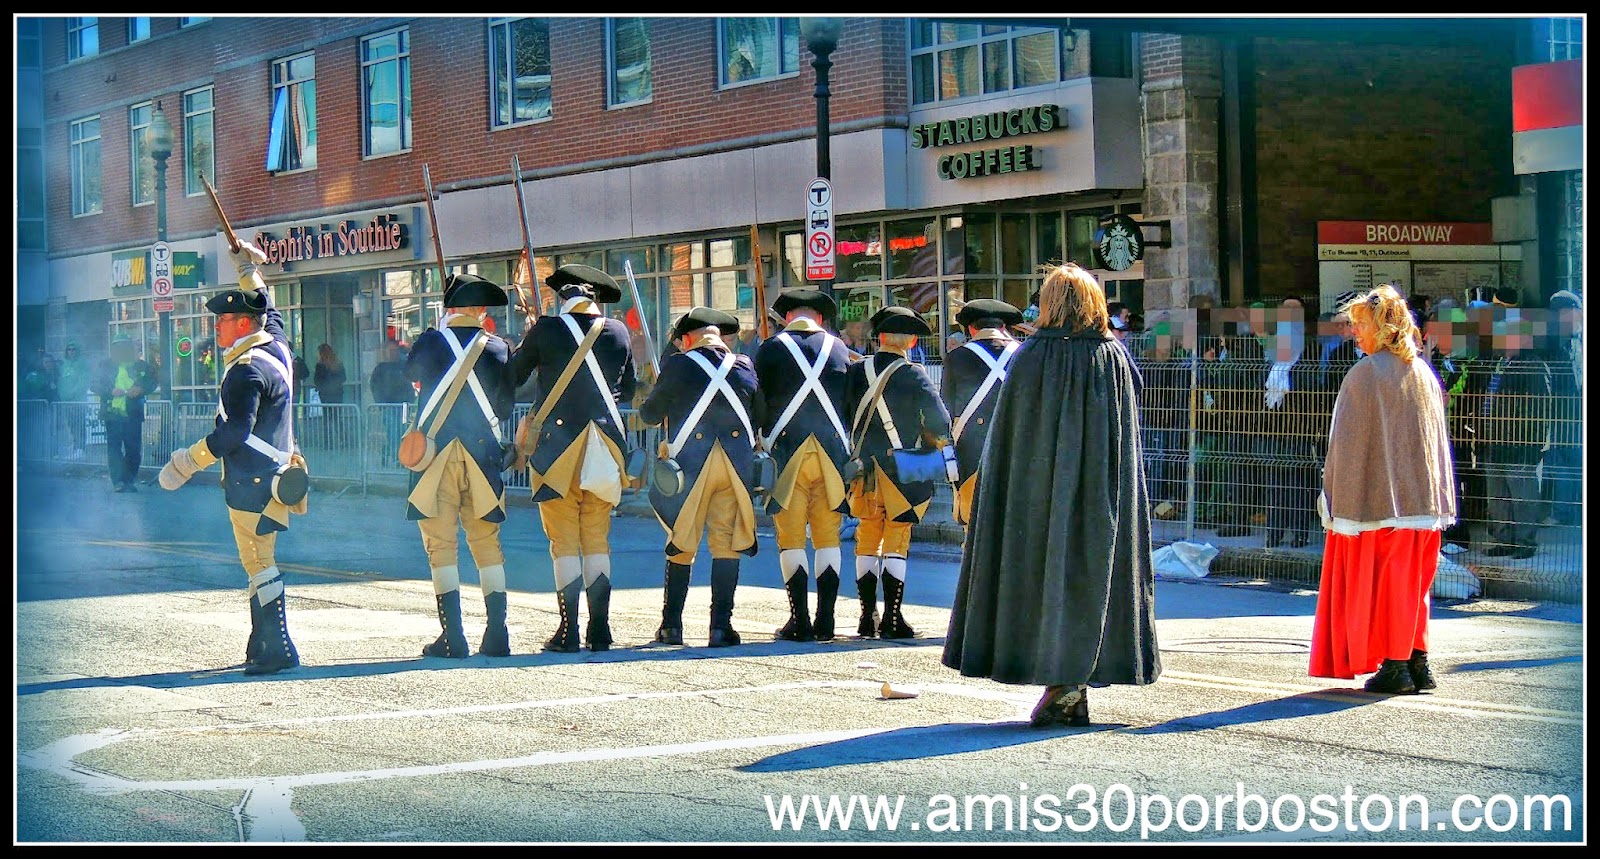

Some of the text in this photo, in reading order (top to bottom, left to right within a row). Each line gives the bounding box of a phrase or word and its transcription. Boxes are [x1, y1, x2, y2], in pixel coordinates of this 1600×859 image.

[911, 103, 1056, 150] STARBUCKS
[936, 144, 1029, 181] COFFEE
[811, 187, 827, 203] T
[254, 214, 402, 272] Stephi's in Southie
[1366, 224, 1453, 243] BROADWAY
[156, 249, 167, 259] T
[111, 256, 145, 288] SUBWA
